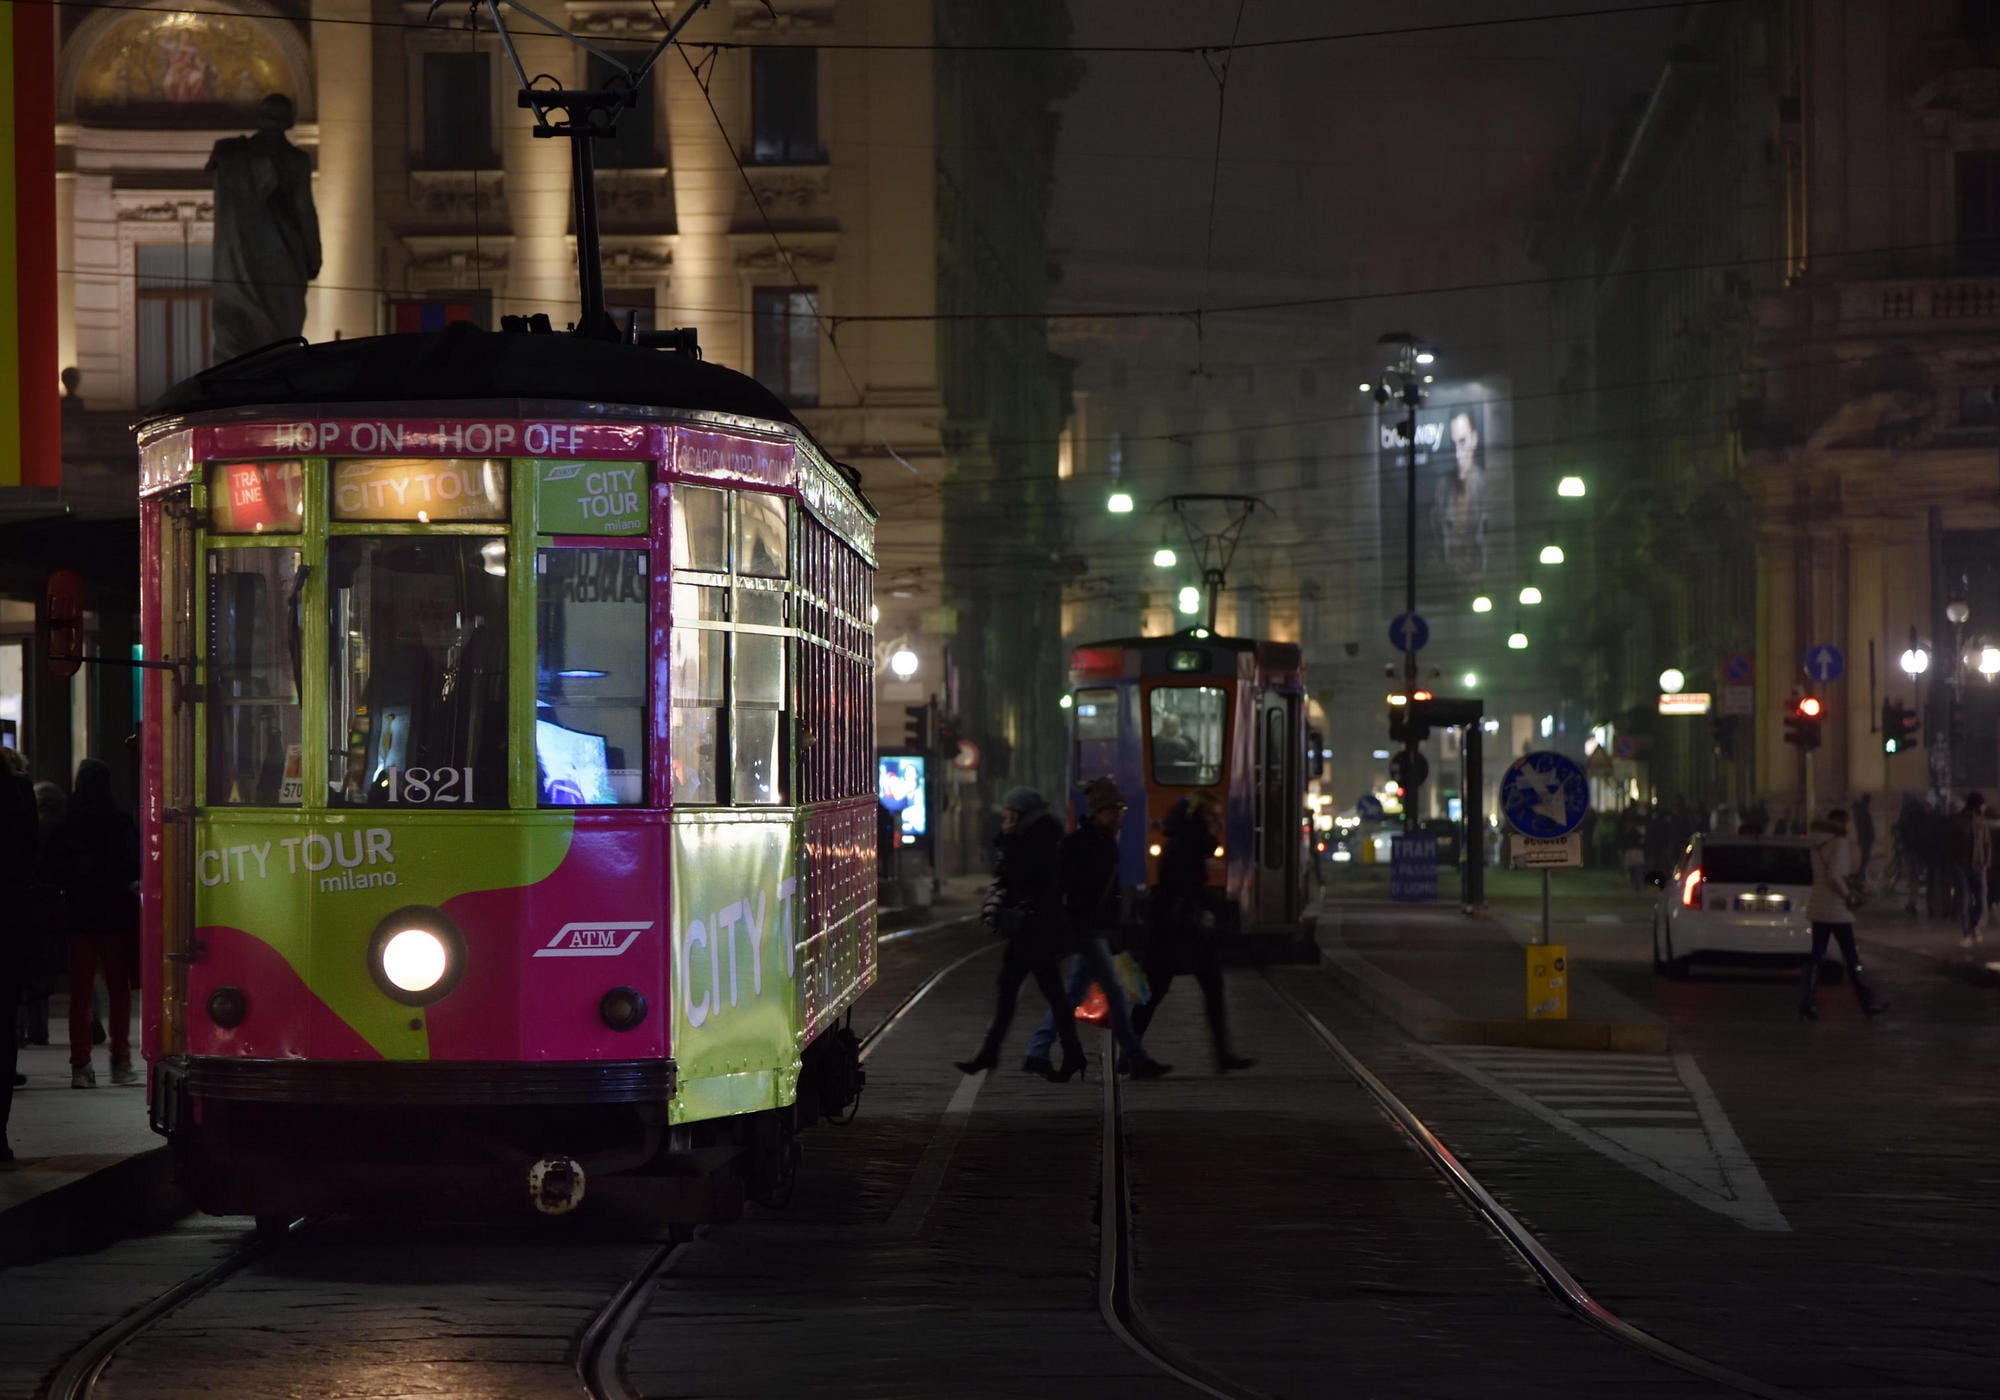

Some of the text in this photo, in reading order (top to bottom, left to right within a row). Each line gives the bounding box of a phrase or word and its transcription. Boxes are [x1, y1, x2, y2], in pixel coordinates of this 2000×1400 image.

[275, 422, 341, 451] HOP
[351, 423, 404, 452] ON
[439, 423, 514, 453] HOP
[524, 424, 585, 454] OFF
[232, 467, 270, 489] TRAM
[338, 468, 503, 513] CITY TOU
[586, 468, 635, 495] CITY
[234, 487, 263, 506] LINE
[577, 491, 639, 519] TOUR
[604, 519, 641, 532] milano
[385, 766, 475, 804] 1821
[200, 828, 395, 887] CITY TOUR
[319, 868, 397, 893] milano
[568, 930, 617, 949] ATM
[681, 889, 767, 1028] CITY
